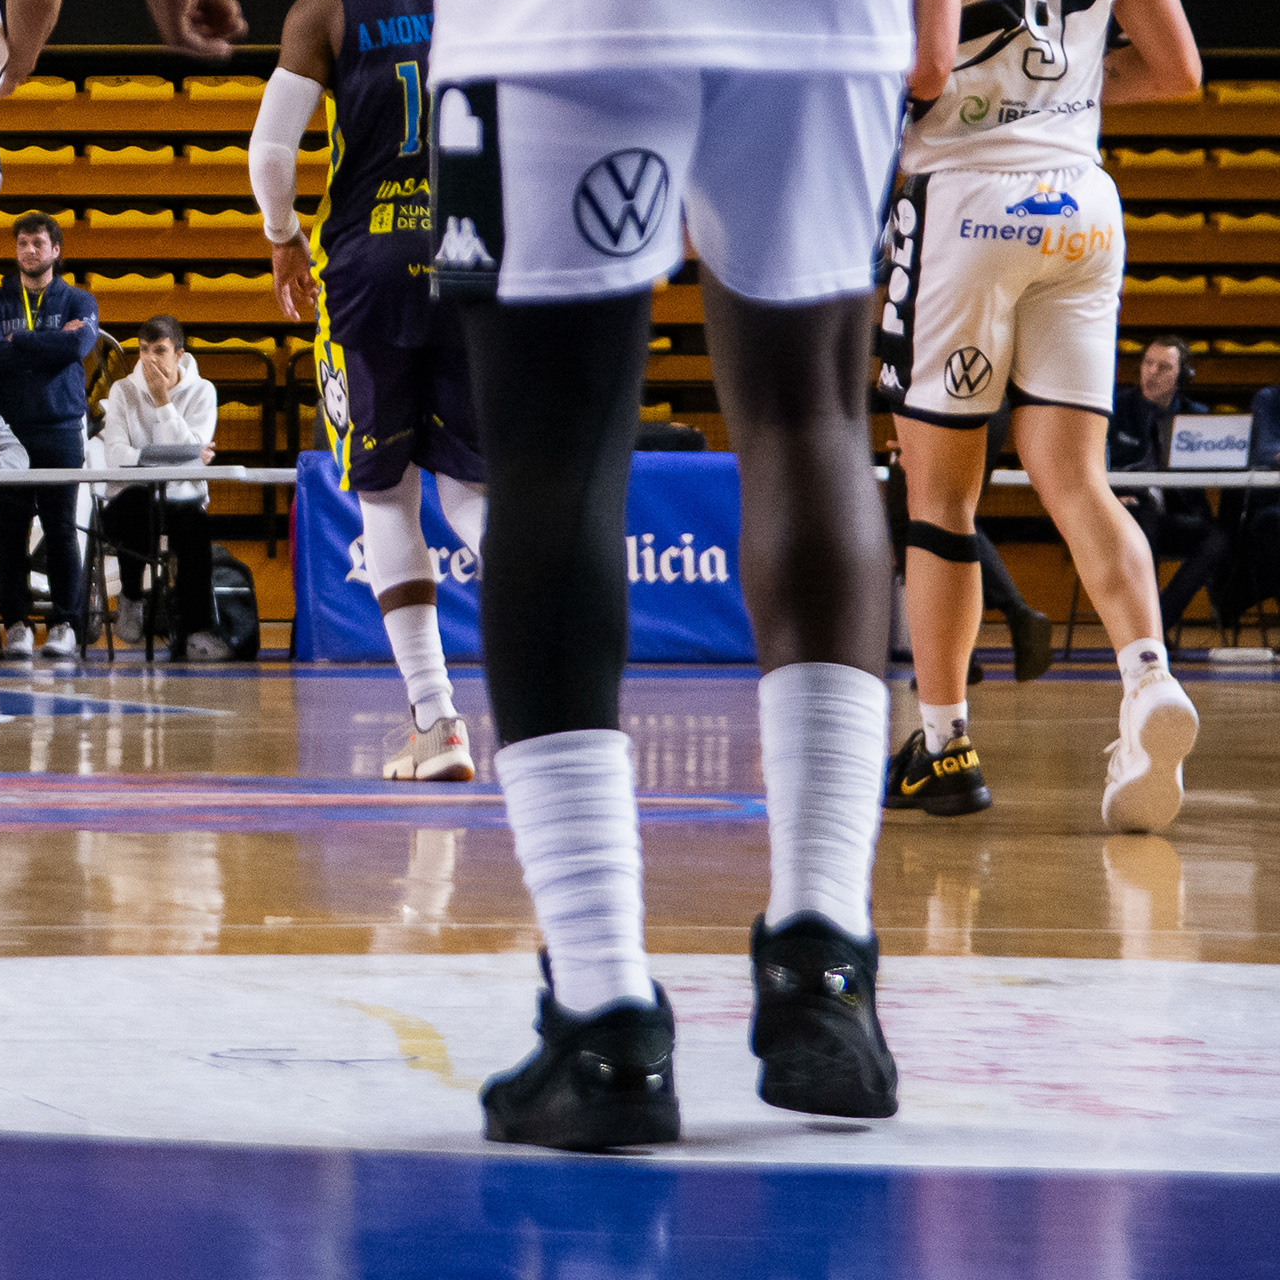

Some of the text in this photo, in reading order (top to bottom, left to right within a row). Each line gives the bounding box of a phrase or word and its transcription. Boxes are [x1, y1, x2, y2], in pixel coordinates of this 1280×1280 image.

[358, 12, 434, 53] A.MON
[396, 217, 416, 230] DE
[626, 532, 730, 584] licia
